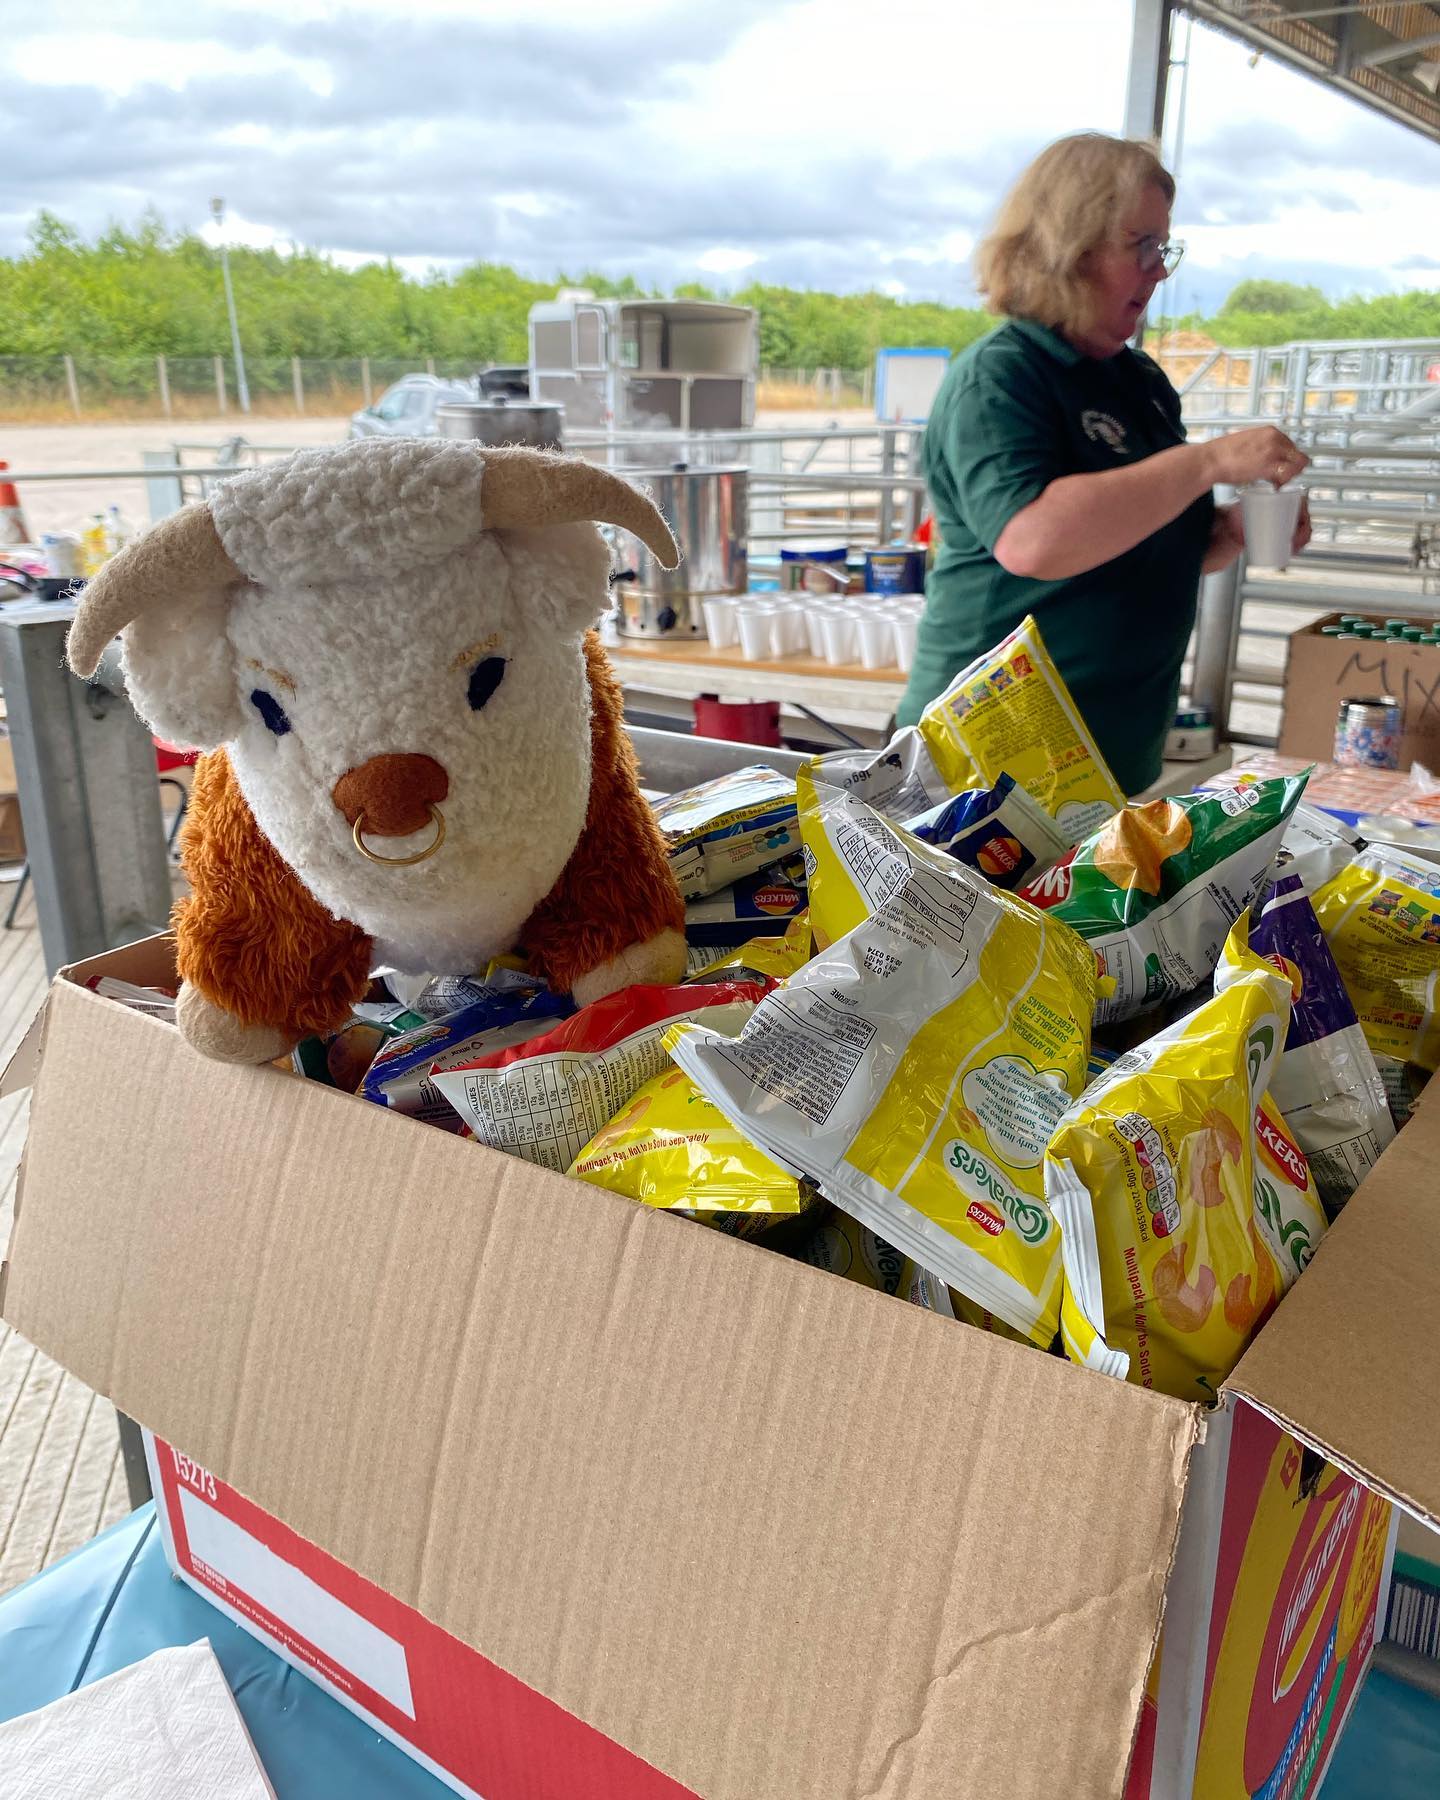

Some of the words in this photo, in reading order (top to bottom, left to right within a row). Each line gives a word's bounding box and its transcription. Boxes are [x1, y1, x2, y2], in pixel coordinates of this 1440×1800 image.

[730, 810, 746, 821] Sold
[985, 837, 1017, 871] WALKERS
[754, 894, 798, 902] WALKERS
[889, 904, 904, 917] after
[916, 903, 941, 924] TYPICAL
[947, 902, 968, 919] ENERGY
[873, 916, 886, 929] dry
[884, 922, 901, 937] cool,
[902, 919, 916, 931] best
[911, 936, 928, 950] Store
[866, 945, 884, 960] 0374
[861, 959, 872, 969] 22
[871, 964, 882, 974] 07
[1018, 1003, 1036, 1019] FOR
[1025, 994, 1076, 1036] VEGETARIANS
[844, 1020, 869, 1042] Contains:
[859, 1021, 873, 1034] May
[1033, 1014, 1069, 1044] SUITABLE
[845, 1030, 865, 1048] Allergy
[817, 1051, 838, 1069] Powder
[832, 1050, 855, 1070] (contains
[1042, 1045, 1056, 1059] NO
[608, 1062, 617, 1084] Snacks
[803, 1060, 830, 1083] Potassium
[811, 1055, 833, 1075] (Paprika
[835, 1061, 852, 1076] Onion
[597, 1063, 610, 1096] Munch?
[782, 1074, 798, 1089] (from
[830, 1067, 848, 1083] Colour
[560, 1087, 568, 1099] 1.4g
[610, 1084, 618, 1097] Corn
[765, 1082, 784, 1098] Potato
[782, 1083, 800, 1099] Potato
[796, 1082, 816, 1100] Powder
[970, 1072, 1002, 1098] tongue,
[468, 1086, 482, 1115] VALUES
[529, 1095, 537, 1106] 12g
[550, 1090, 558, 1102] 0.3g
[782, 1092, 804, 1111] Flavour
[798, 1092, 828, 1117] Ingredients:
[998, 1091, 1018, 1107] your
[585, 1105, 595, 1130] contains
[802, 1104, 824, 1123] Cheese
[988, 1108, 1005, 1123] two
[1016, 1101, 1038, 1117] around
[566, 1117, 574, 1130] 7.0g
[576, 1112, 584, 1127] 1.70g
[1004, 1119, 1016, 1129] no
[1013, 1111, 1037, 1129] Some
[1037, 1111, 1058, 1128] wrap
[1131, 1120, 1144, 1136] kcal
[517, 1125, 526, 1141] 25.0g
[535, 1122, 544, 1137] 59.0g
[543, 1123, 552, 1135] 3.0g
[995, 1126, 1016, 1142] little
[1160, 1125, 1171, 1142] This
[1166, 1141, 1178, 1159] pack
[1254, 1114, 1309, 1182] LKERS
[549, 1146, 558, 1165] Sugars
[575, 1154, 613, 1174] Multipack
[612, 1149, 629, 1162] Bag,
[627, 1144, 641, 1155] Not
[640, 1142, 648, 1151] to
[652, 1137, 667, 1149] Sold
[667, 1130, 710, 1150] Separately
[1333, 1147, 1343, 1159] FAT
[1350, 1141, 1366, 1166] ENERGY
[949, 1144, 1049, 1243] Quavers
[1107, 1130, 1128, 1157] Energy
[1122, 1168, 1138, 1190] 100g:
[1134, 1214, 1152, 1243] 536kcal
[1157, 1186, 1169, 1203] 0.4g
[966, 1201, 1004, 1237] WALKERS
[1122, 1248, 1145, 1301] Multipack
[1136, 1333, 1149, 1347] be
[1137, 1349, 1152, 1376] Sold
[1280, 1485, 1360, 1657] WALKERS
[1306, 1636, 1335, 1712] ONION
[1294, 1694, 1323, 1768] SALTED
